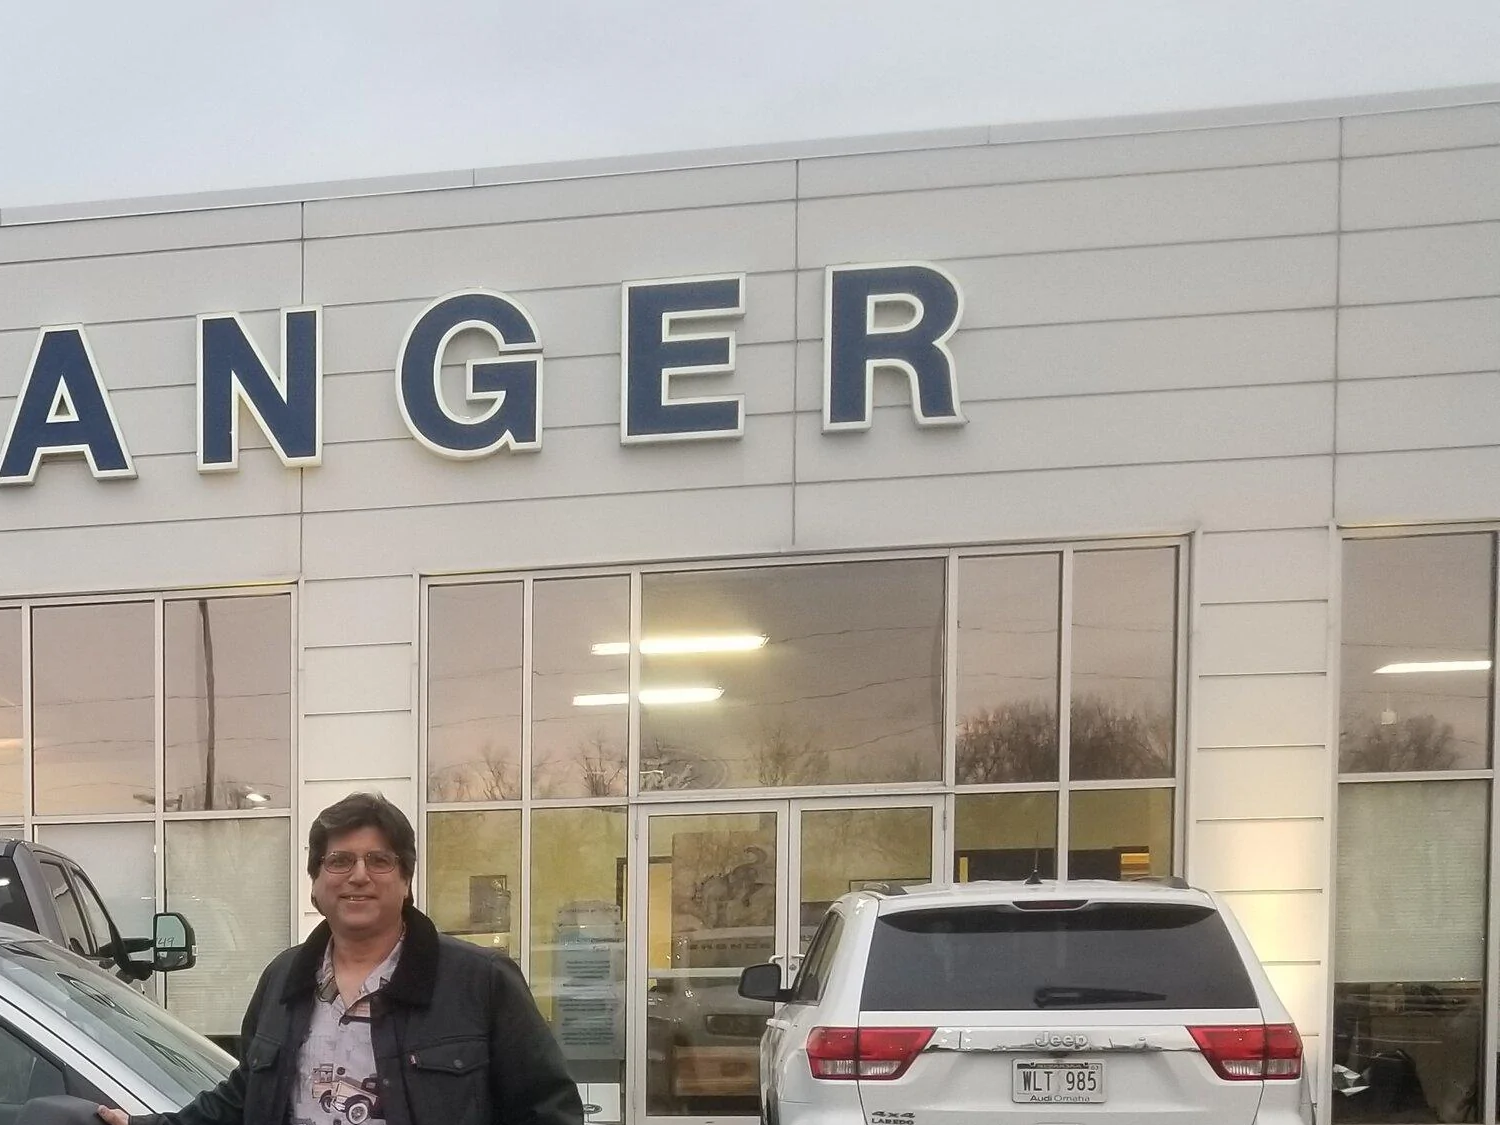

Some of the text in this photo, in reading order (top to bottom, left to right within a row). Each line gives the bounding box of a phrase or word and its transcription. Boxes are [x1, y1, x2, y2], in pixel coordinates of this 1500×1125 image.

[1034, 1030, 1088, 1051] Jeep
[1022, 1071, 1097, 1091] WLT 985
[1029, 1094, 1052, 1102] Audi
